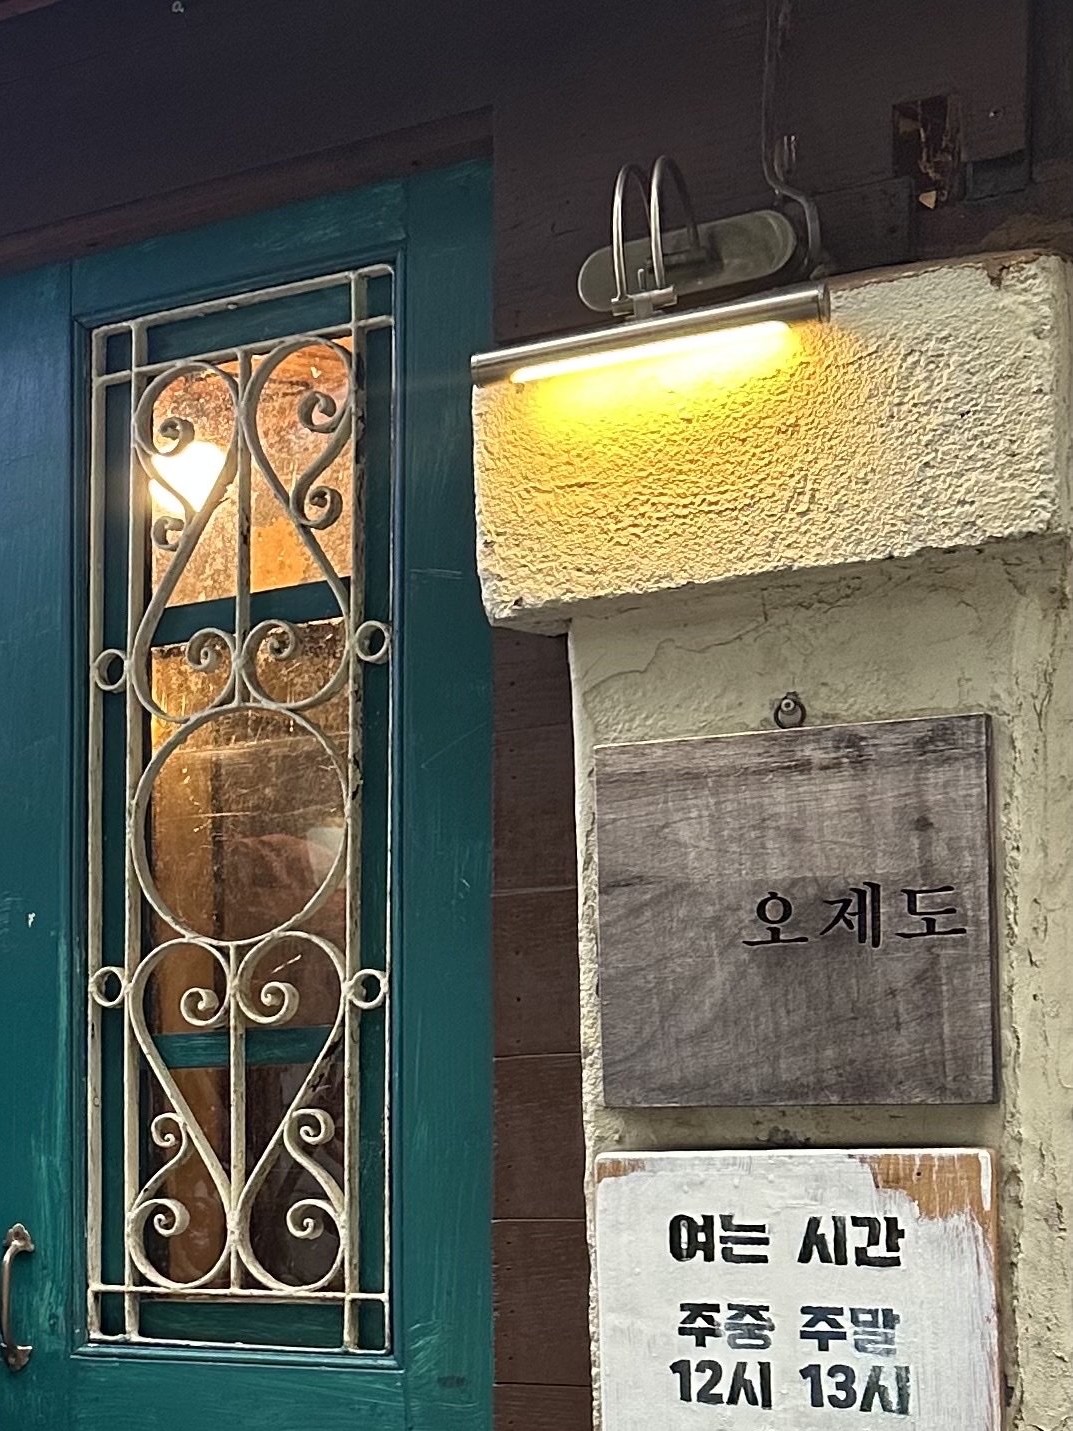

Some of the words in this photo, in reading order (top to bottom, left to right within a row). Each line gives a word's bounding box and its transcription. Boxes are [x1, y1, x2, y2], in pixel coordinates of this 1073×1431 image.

[742, 881, 967, 949] 오제도
[669, 1213, 771, 1263] 여는
[797, 1214, 905, 1268] 시간
[677, 1302, 776, 1350] 주중
[800, 1304, 901, 1356] 주말
[669, 1359, 773, 1410] 12시
[799, 1363, 912, 1415] 13시
